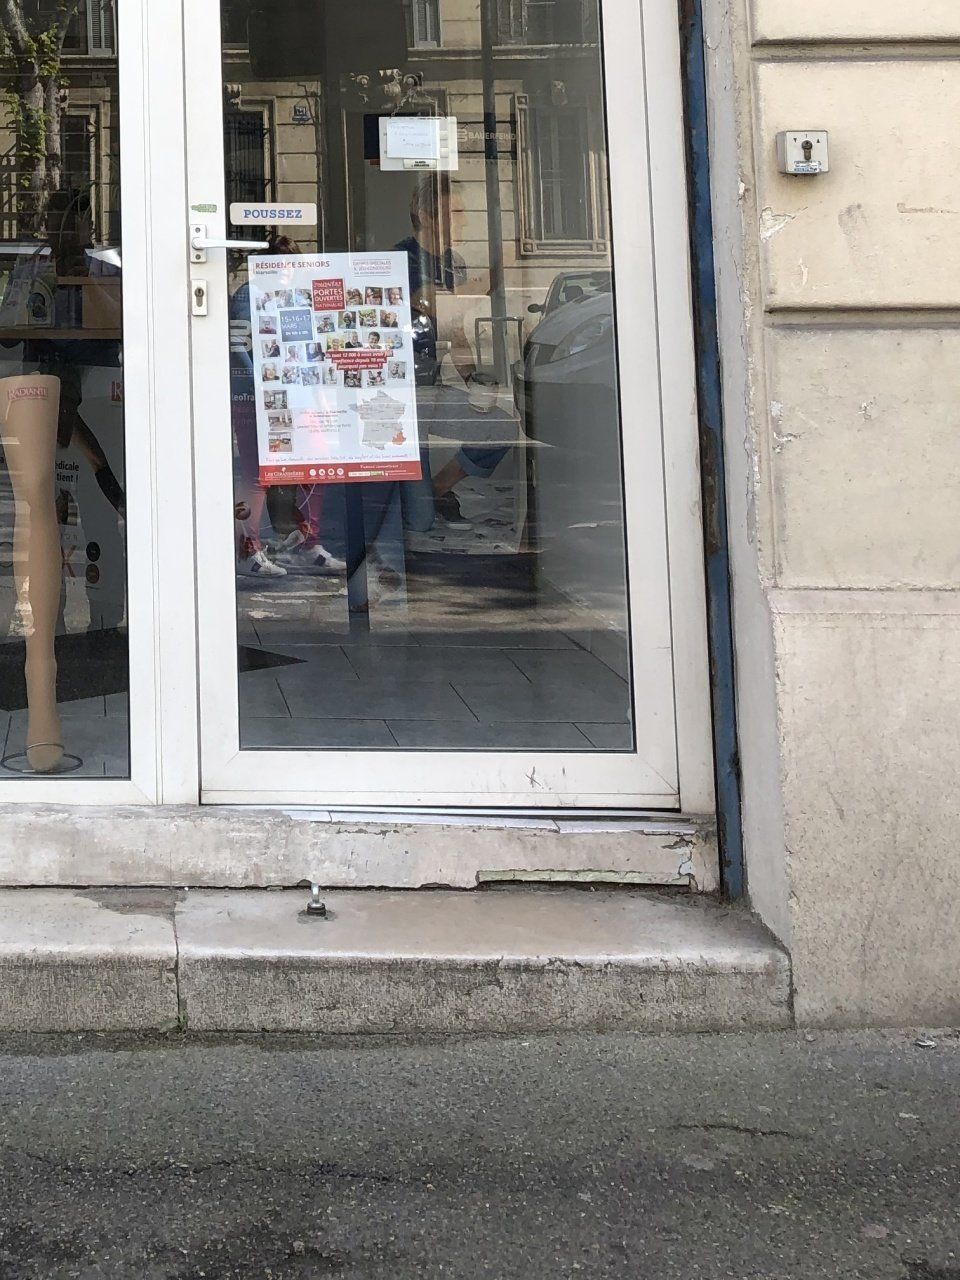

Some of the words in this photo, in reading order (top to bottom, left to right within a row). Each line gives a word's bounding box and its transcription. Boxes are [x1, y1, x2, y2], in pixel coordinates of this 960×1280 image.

[243, 209, 303, 219] POUSSEZ
[297, 260, 330, 268] SENIORS
[313, 287, 343, 296] PORTES
[8, 387, 48, 398] RADIANTE
